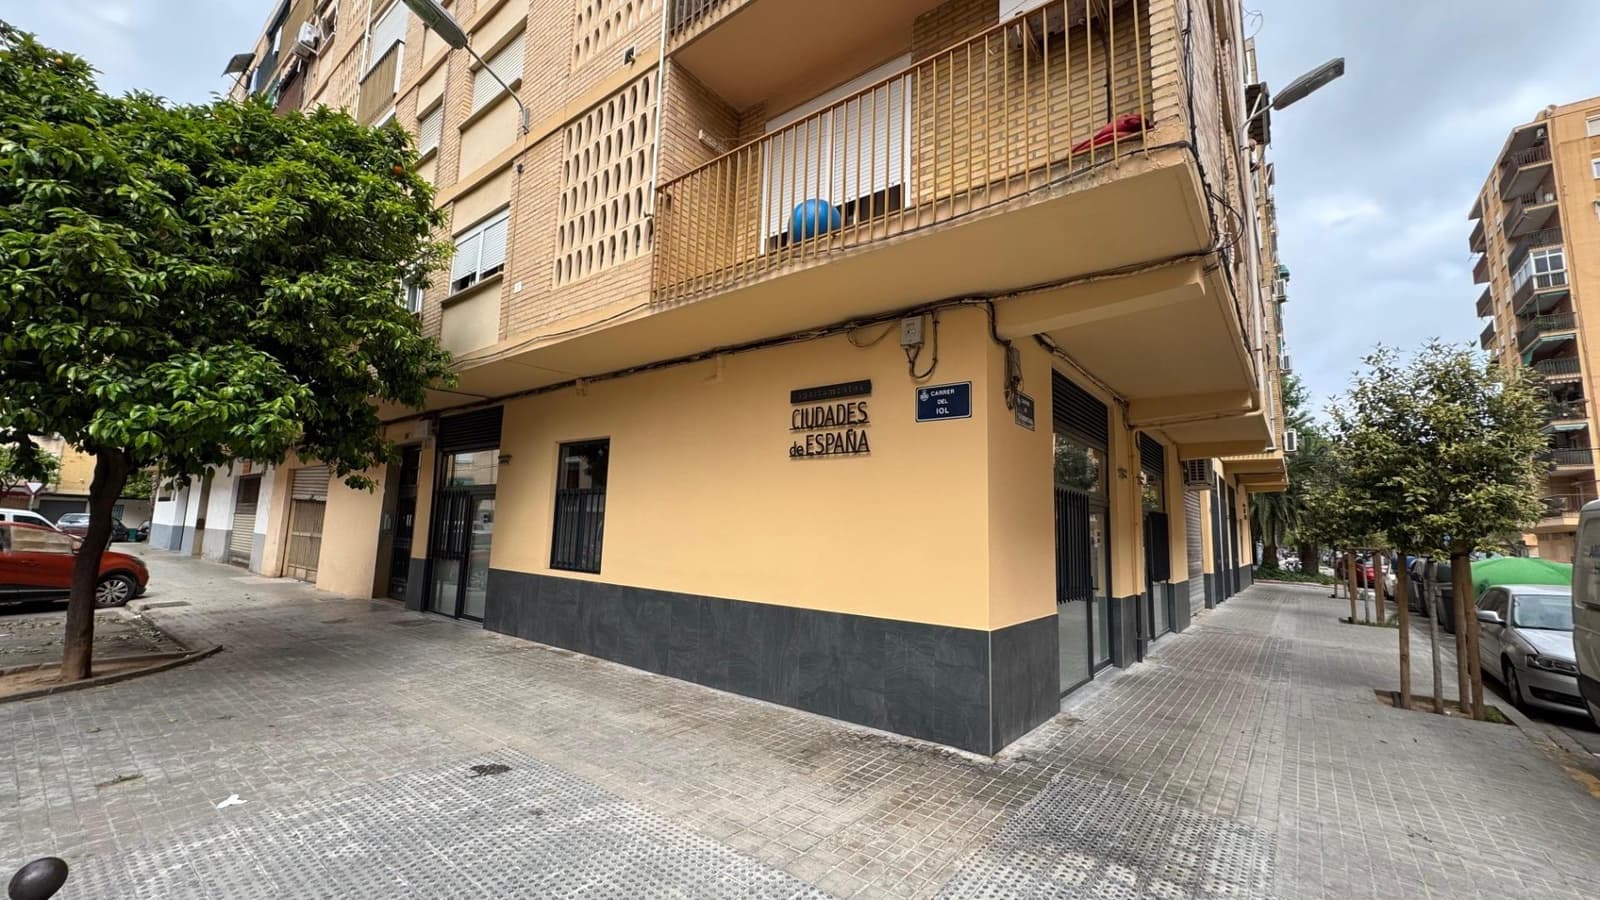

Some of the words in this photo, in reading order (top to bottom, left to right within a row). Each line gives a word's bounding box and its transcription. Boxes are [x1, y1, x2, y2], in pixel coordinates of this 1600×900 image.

[930, 388, 955, 397] CARRER
[791, 401, 869, 430] CIUDADES
[936, 407, 949, 415] IOL
[789, 441, 804, 457] de
[805, 428, 870, 456] ESPAÑA
